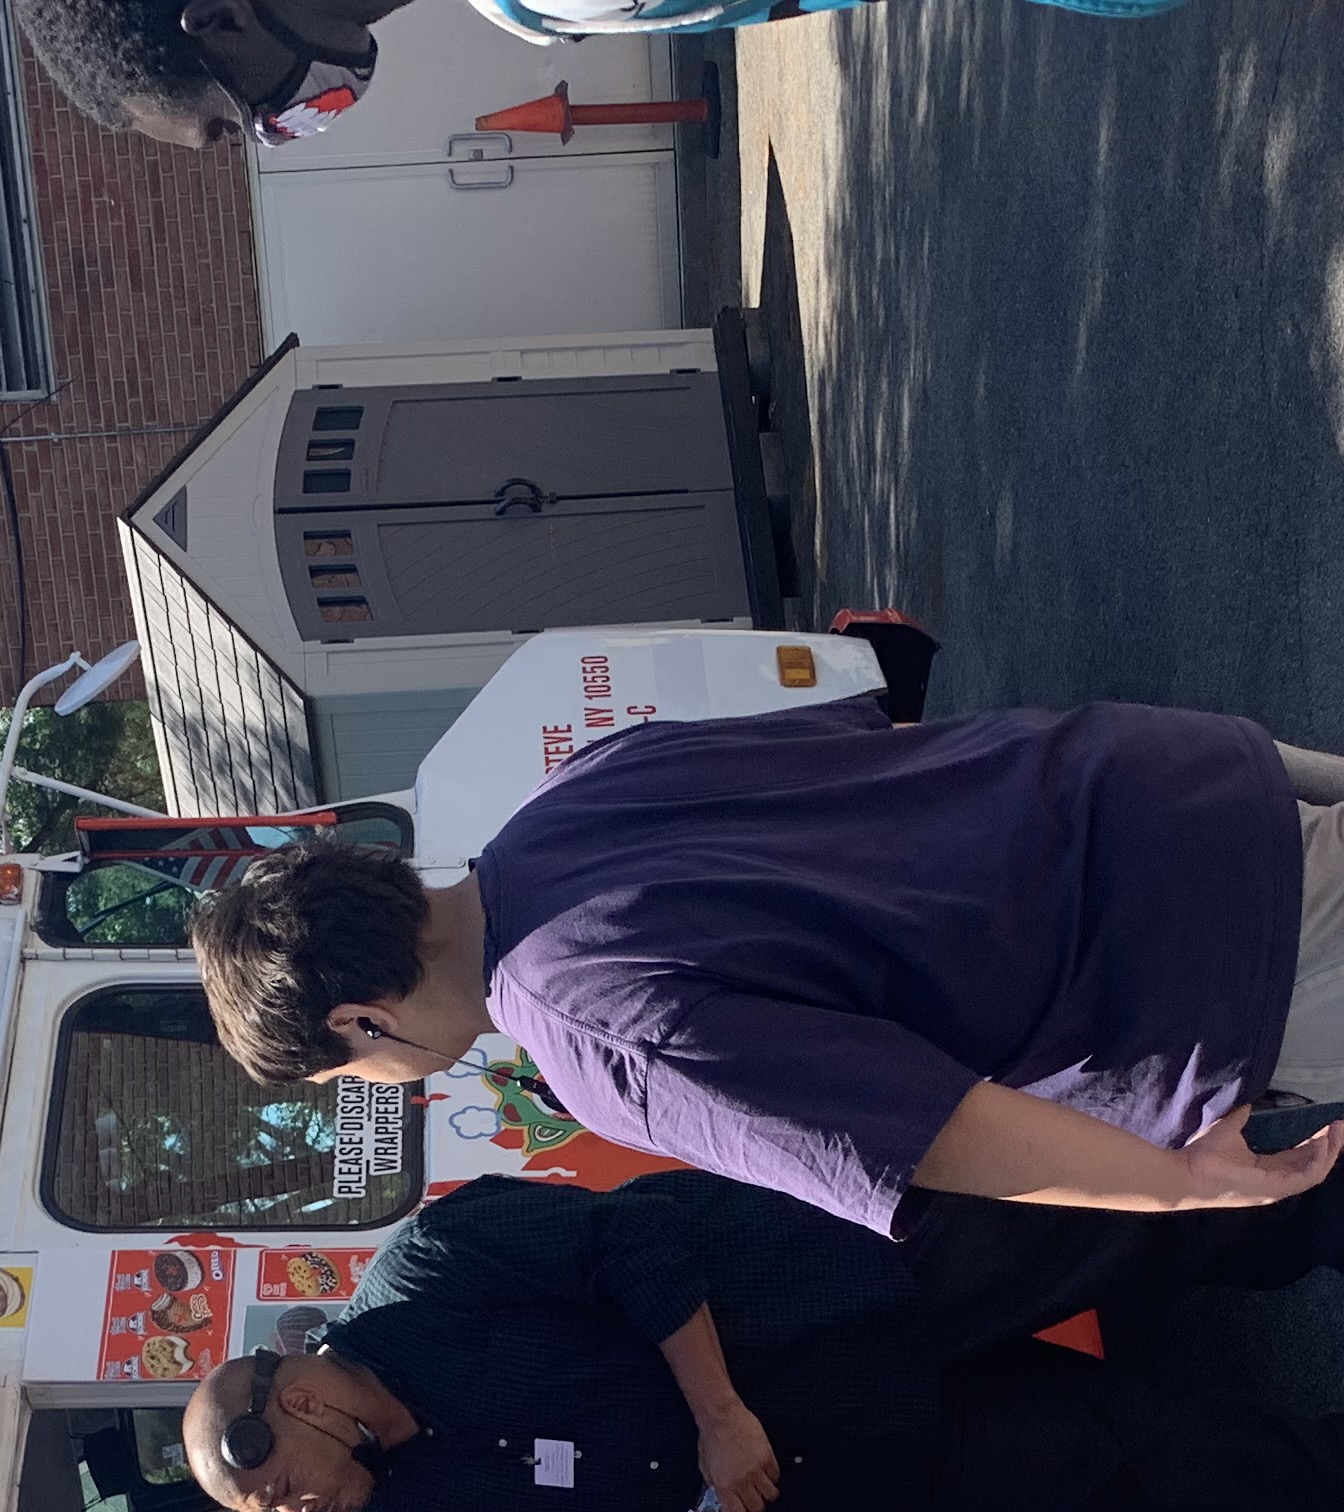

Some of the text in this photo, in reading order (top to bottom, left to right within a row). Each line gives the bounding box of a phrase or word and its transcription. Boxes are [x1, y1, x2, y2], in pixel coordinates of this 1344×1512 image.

[580, 655, 615, 728] NY 10550
[373, 1084, 400, 1173] WRAPPERS
[337, 1136, 364, 1195] PLEASE
[211, 1250, 224, 1281] OREO
